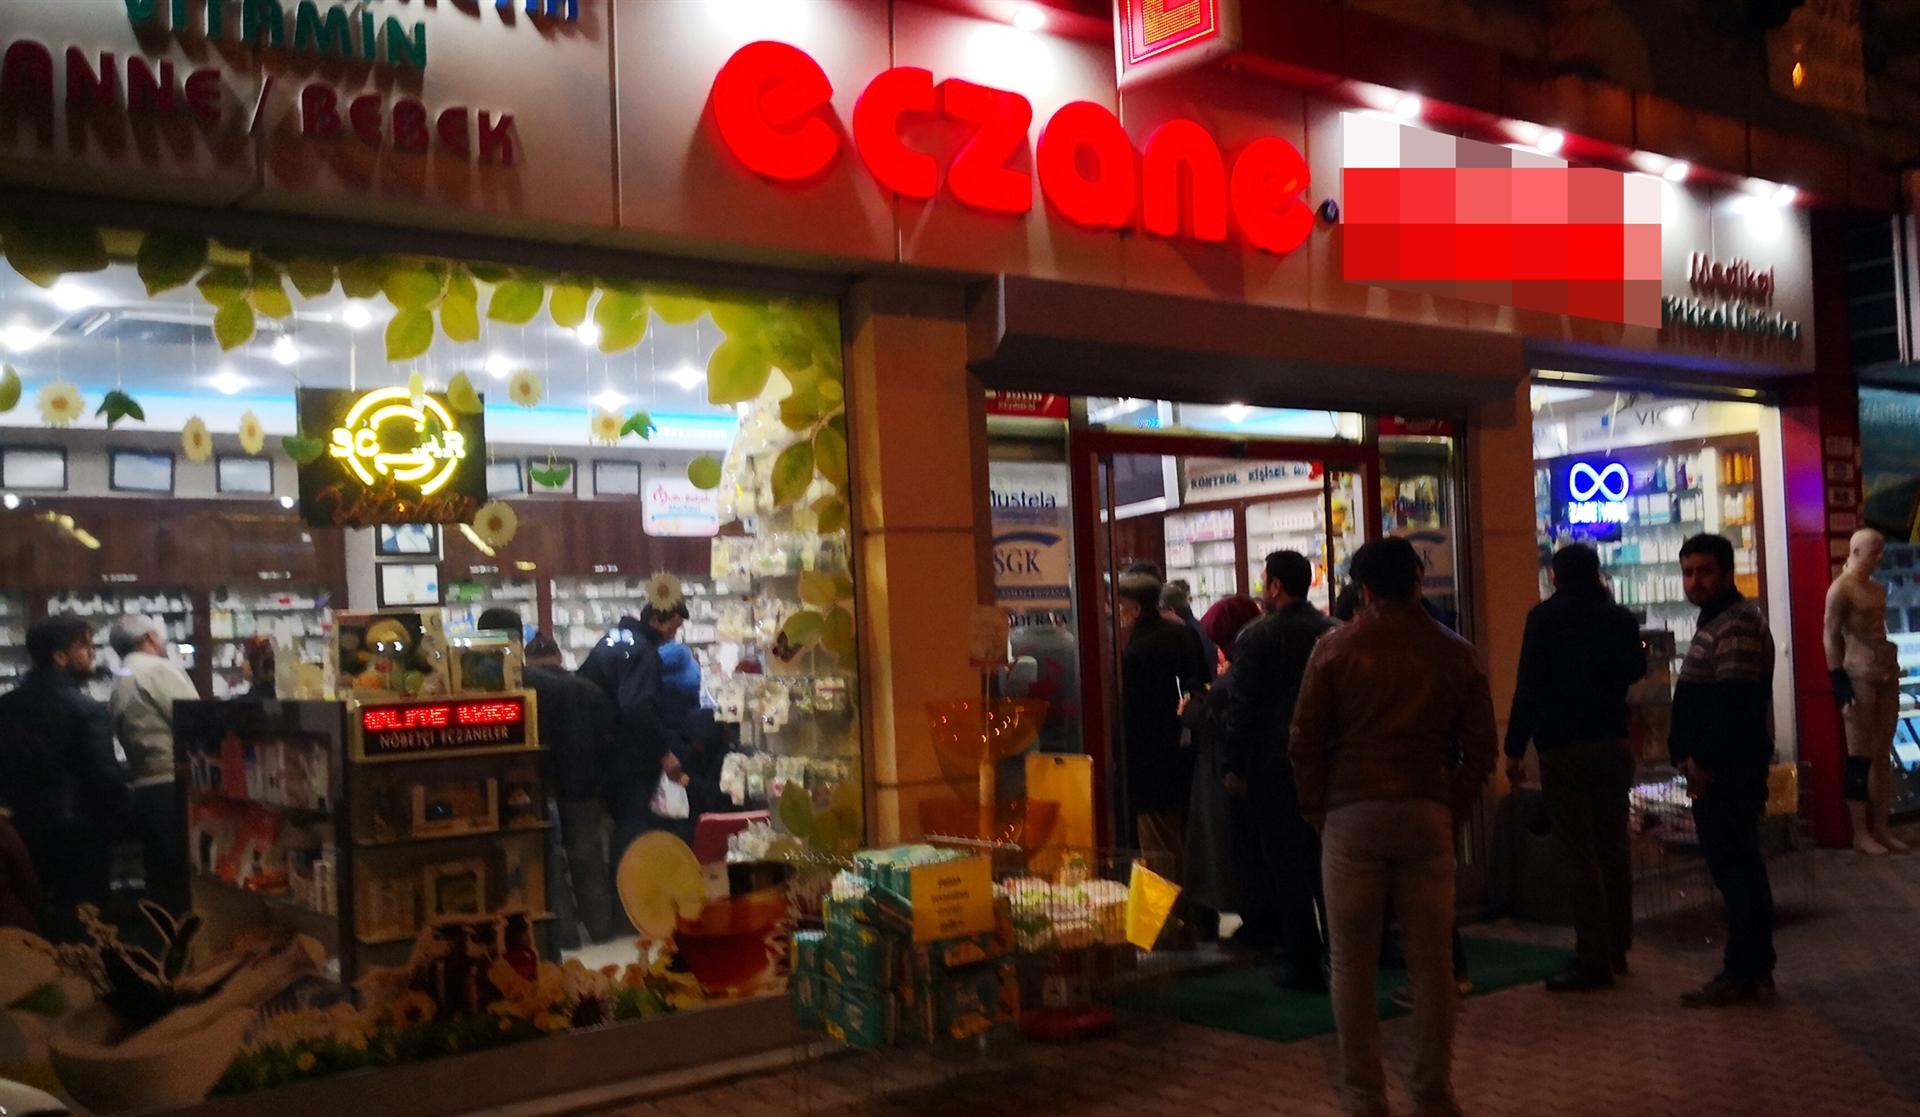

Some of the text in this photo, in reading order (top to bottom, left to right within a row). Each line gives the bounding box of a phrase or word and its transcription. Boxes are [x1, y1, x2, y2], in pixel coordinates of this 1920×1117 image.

[1, 39, 222, 121] ANNE
[301, 83, 515, 165] BEBEK
[993, 548, 1041, 575] SGK
